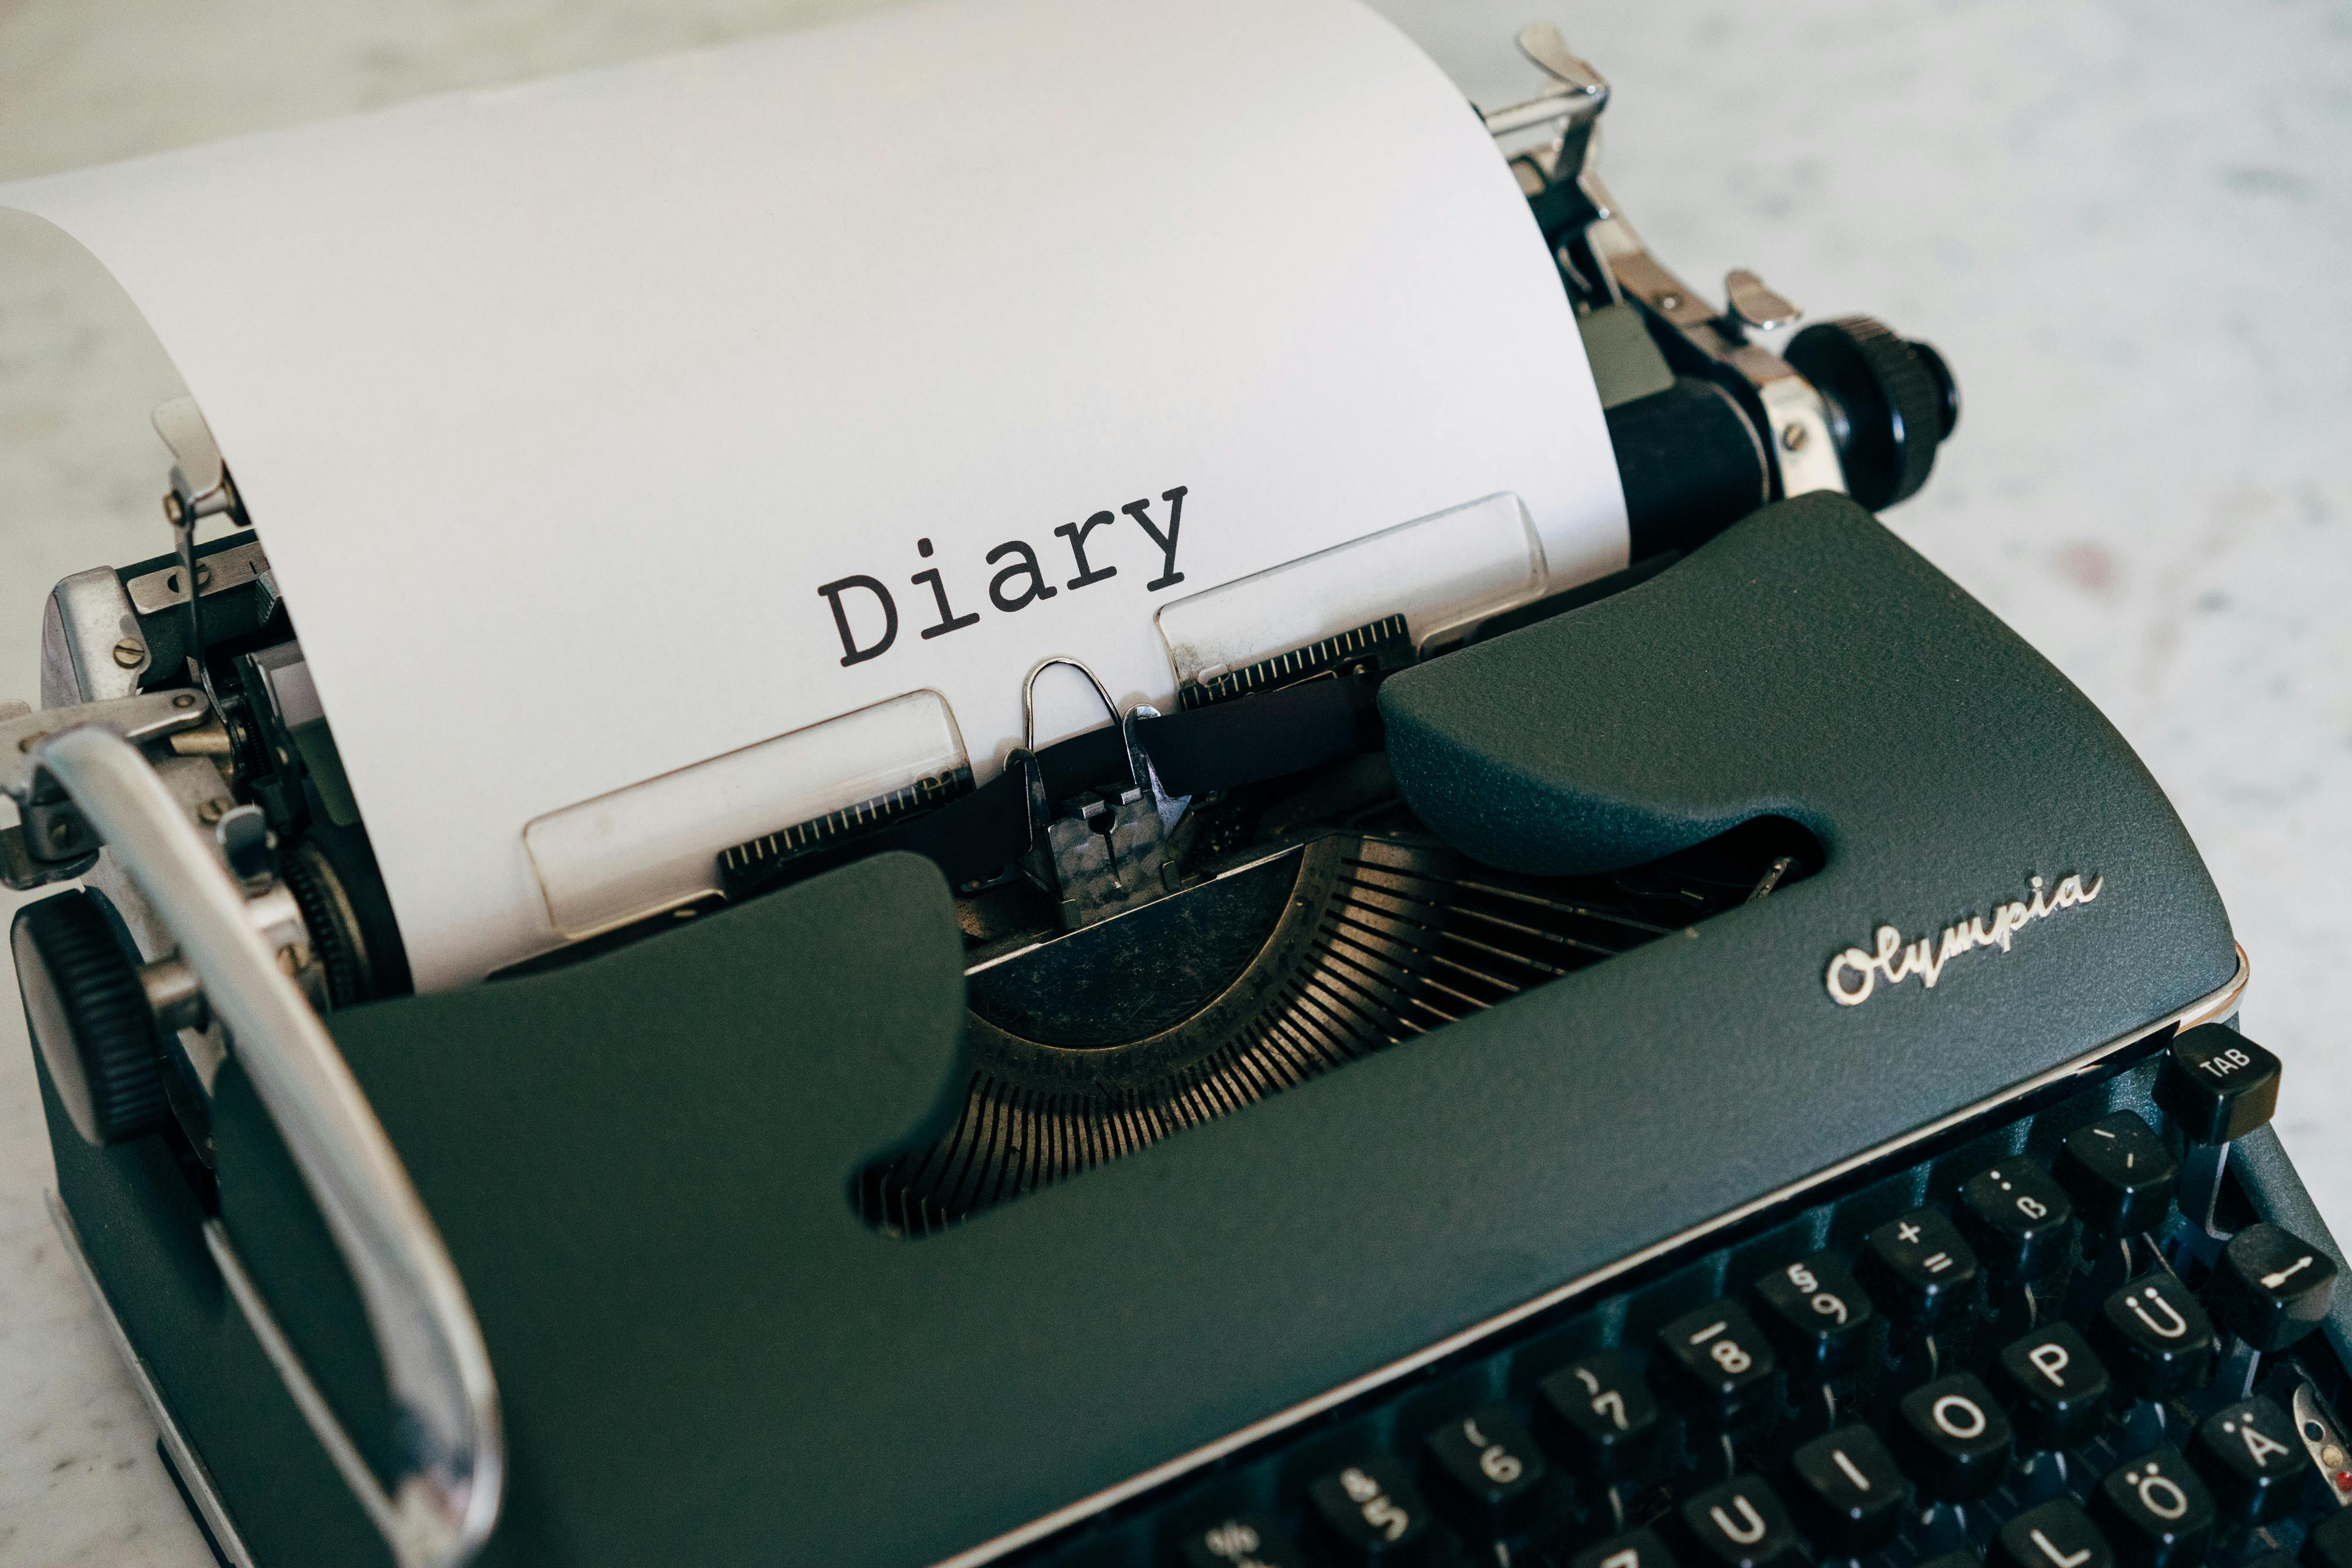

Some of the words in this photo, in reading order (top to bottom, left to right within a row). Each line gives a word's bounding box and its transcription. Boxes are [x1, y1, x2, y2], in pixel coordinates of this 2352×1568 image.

[818, 485, 1188, 668] Diary
[1827, 874, 2104, 1005] Olympia
[2200, 1049, 2250, 1077] TAB
[1899, 1223, 1920, 1243] +
[1812, 1294, 1847, 1323] 9
[2126, 1287, 2186, 1337] Ü
[1712, 1341, 1750, 1373] 8
[2030, 1344, 2068, 1386] P
[1592, 1390, 1627, 1429] 7
[1933, 1396, 1985, 1437] O
[2223, 1412, 2288, 1466] Ä
[1480, 1444, 1522, 1483] 6
[1834, 1451, 1869, 1489] I
[2126, 1463, 2187, 1519] Ö
[1362, 1496, 1408, 1541] 5
[1711, 1496, 1764, 1543] U
[2031, 1530, 2090, 1568] L
